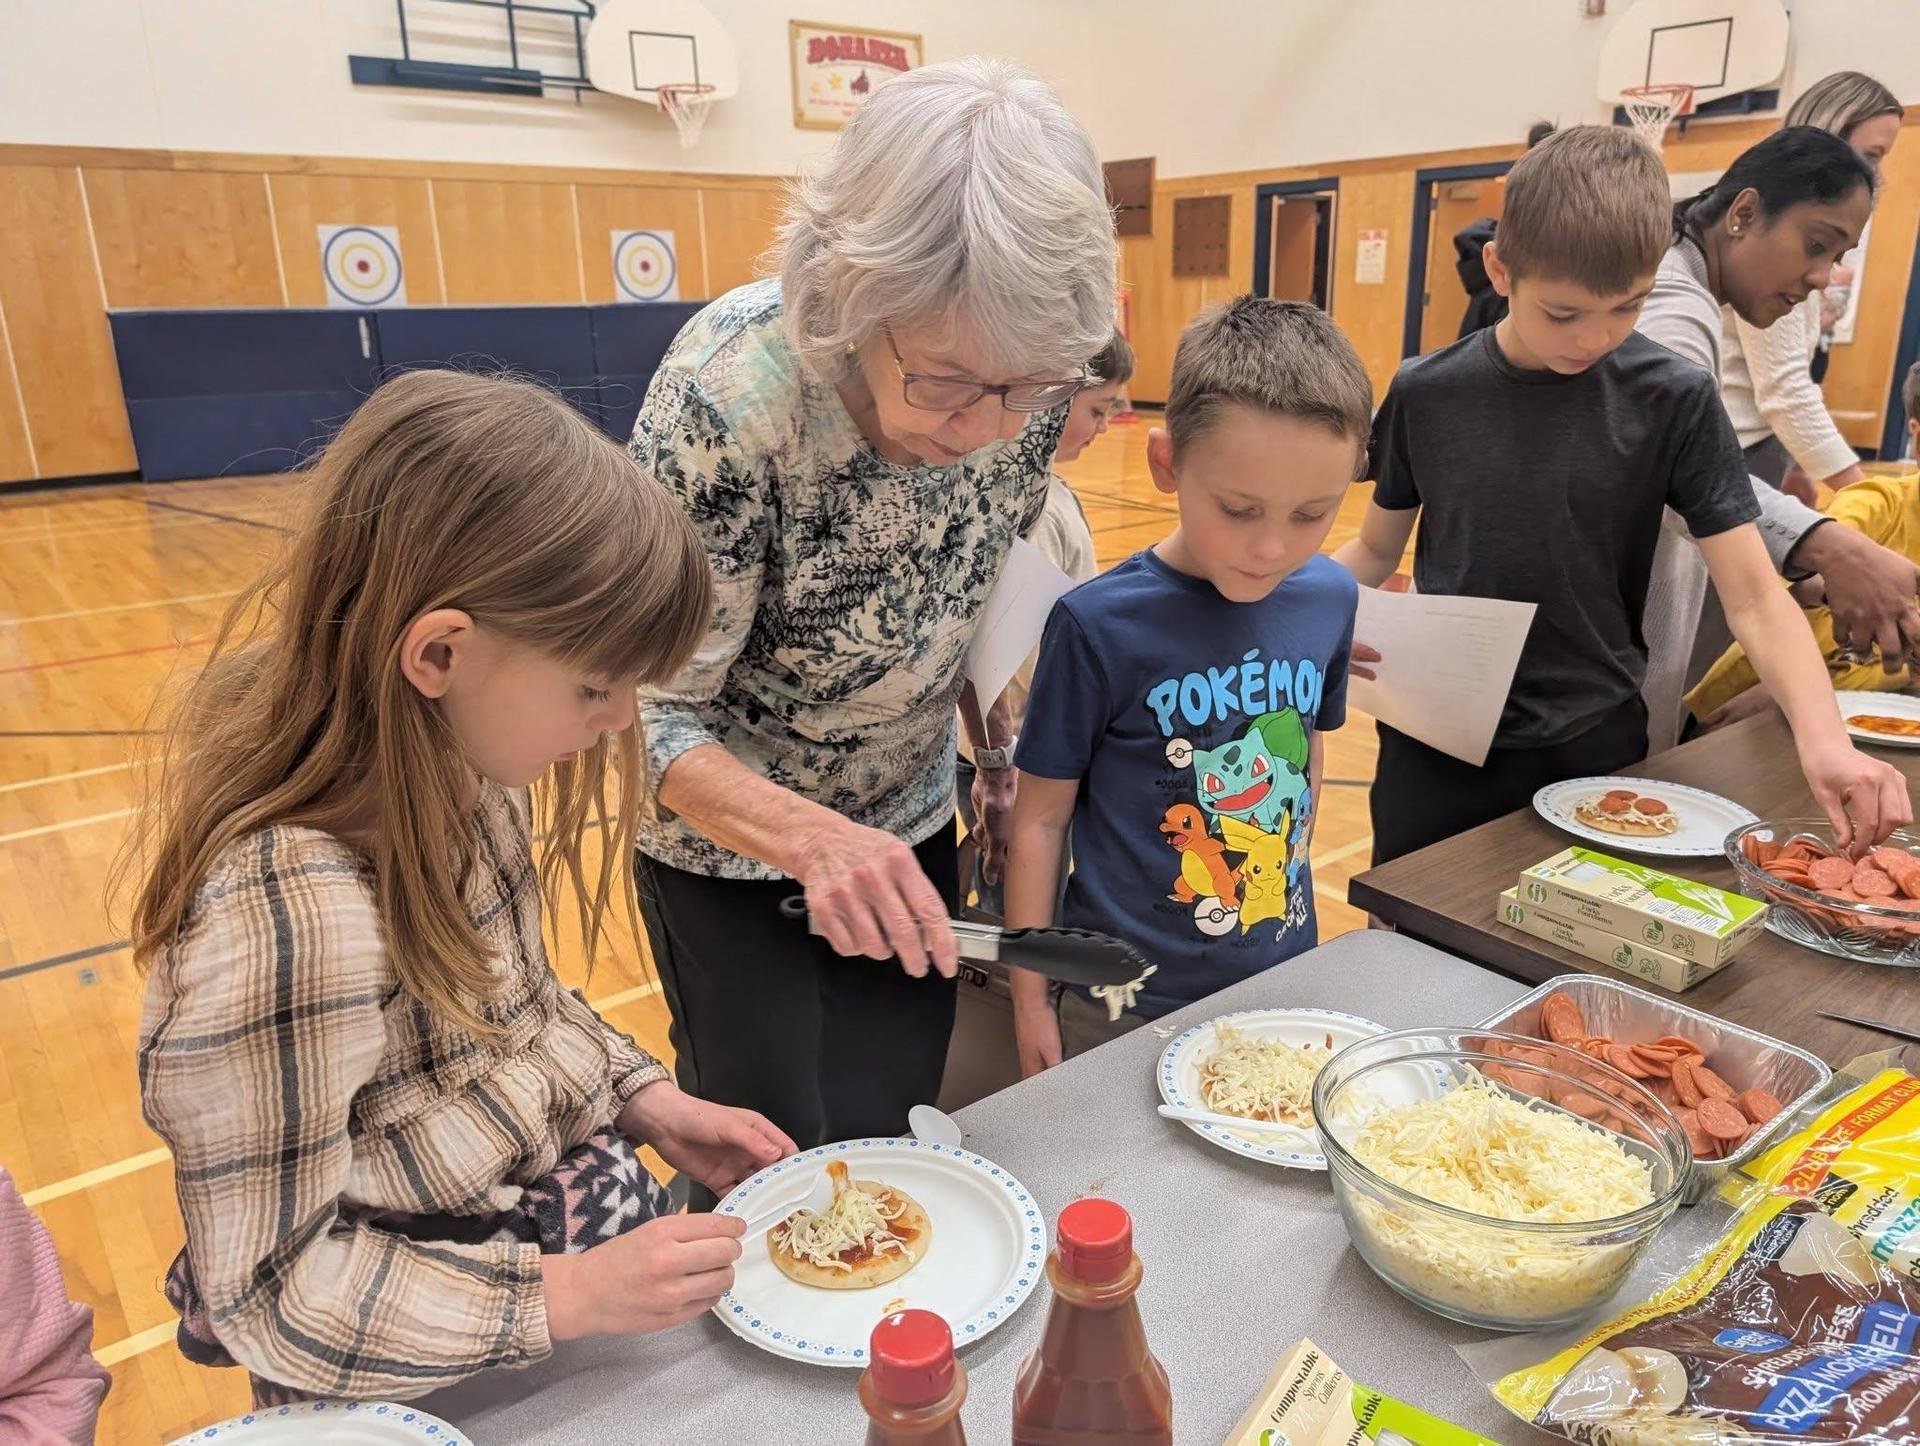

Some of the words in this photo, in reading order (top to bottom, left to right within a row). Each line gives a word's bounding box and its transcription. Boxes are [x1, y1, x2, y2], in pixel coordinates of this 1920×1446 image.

[1557, 889, 1602, 908] Compostable
[1854, 1094, 1901, 1128] FORMAT
[1270, 1350, 1319, 1424] Compostable
[1302, 1370, 1327, 1401] Spoons
[1765, 1378, 1824, 1429] PIZZA
